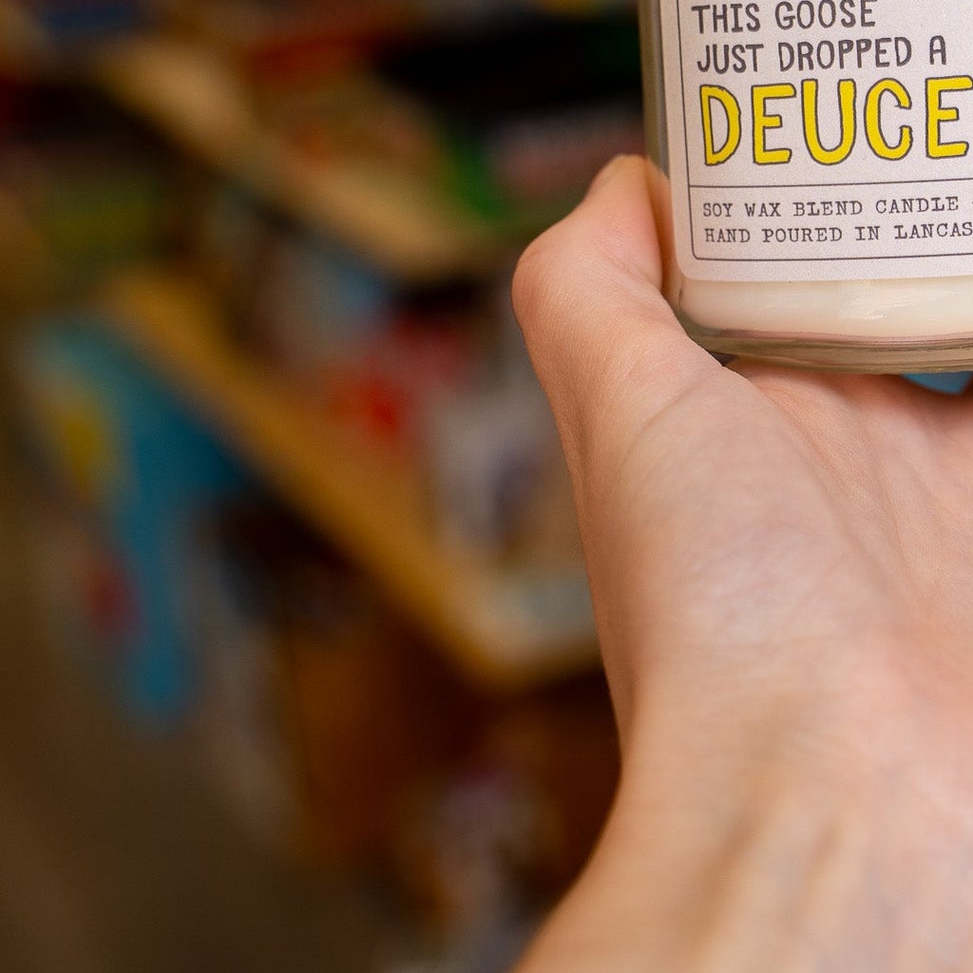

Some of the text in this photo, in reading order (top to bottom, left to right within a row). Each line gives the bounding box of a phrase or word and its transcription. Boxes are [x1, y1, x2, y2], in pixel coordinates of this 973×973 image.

[691, 3, 761, 34] THIS
[697, 35, 947, 74] JUST DROPPED A
[703, 203, 733, 218] SOY
[745, 202, 781, 218] WAX
[793, 200, 863, 217] BLEND
[875, 196, 960, 214] CANDLE
[705, 228, 751, 243] HAND
[762, 227, 843, 243] POURED
[855, 226, 881, 241] IN
